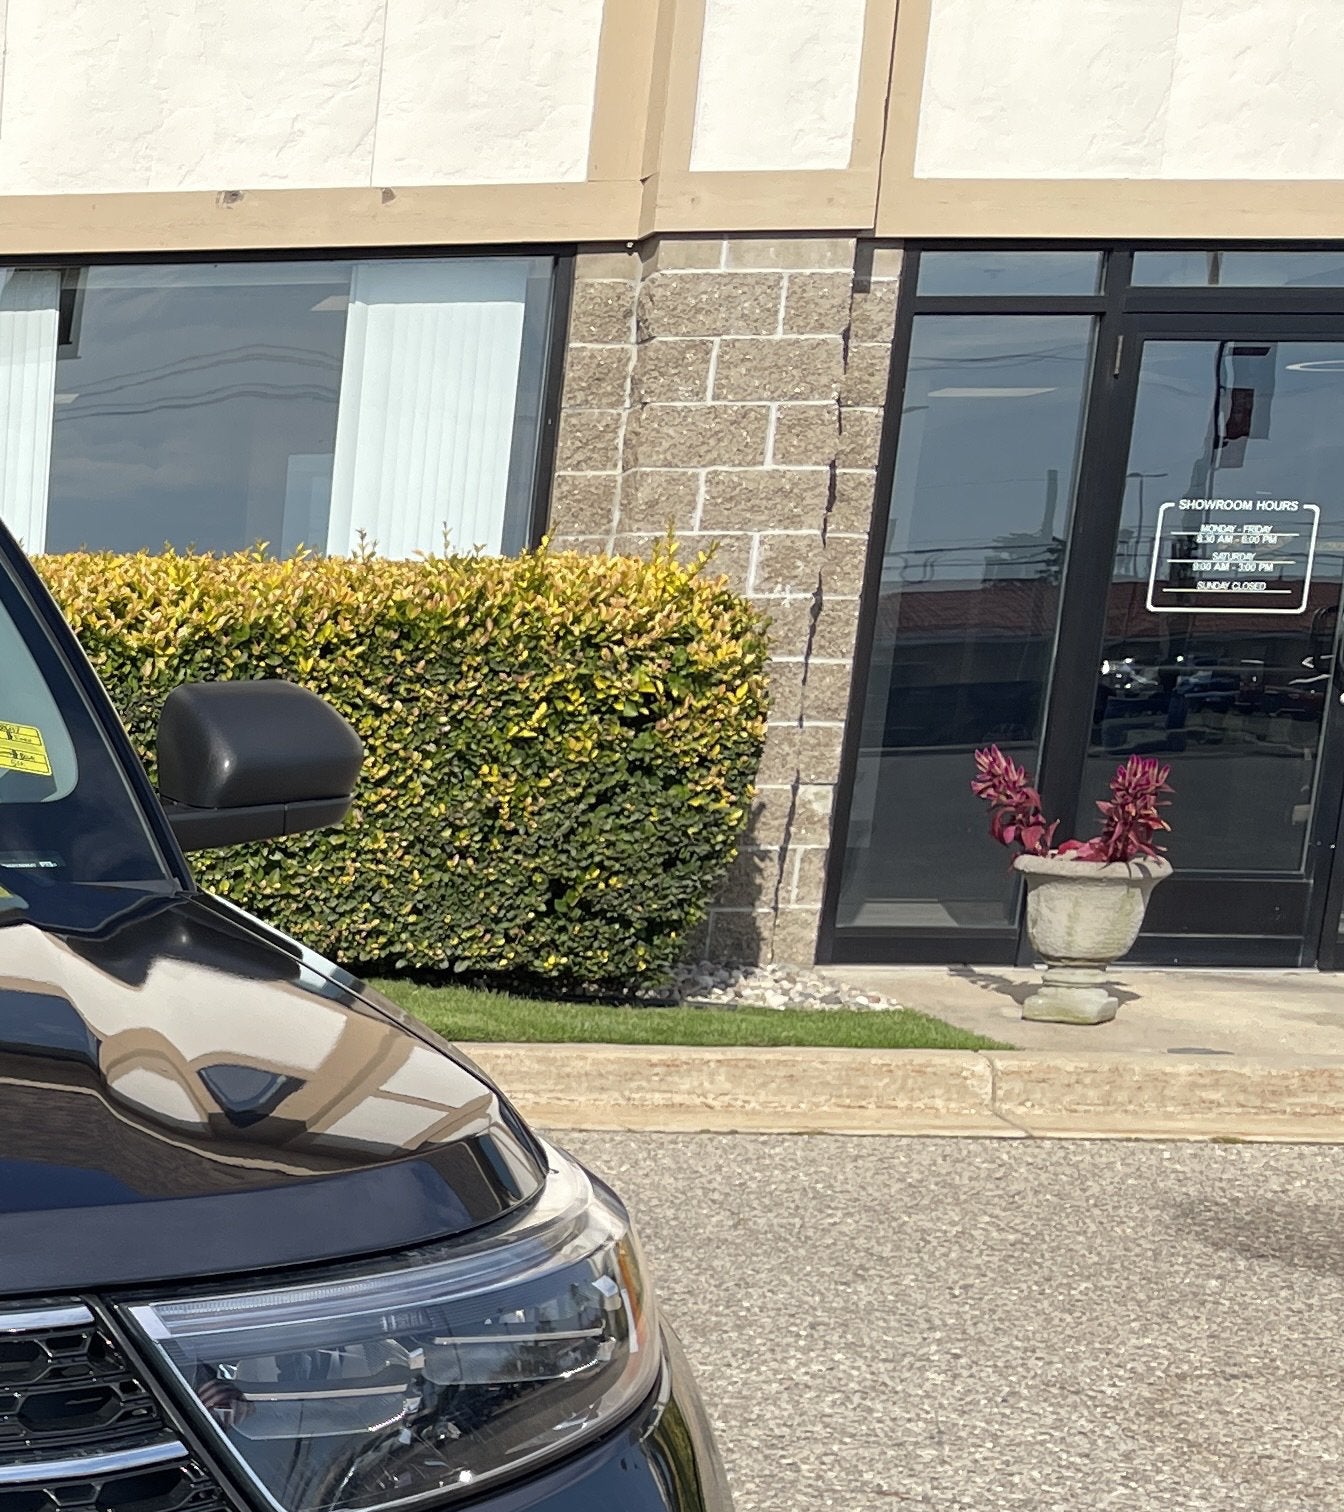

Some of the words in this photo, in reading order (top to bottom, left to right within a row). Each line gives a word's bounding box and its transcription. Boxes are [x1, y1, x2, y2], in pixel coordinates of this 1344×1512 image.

[1178, 499, 1253, 511] SHOWROOM
[1256, 500, 1300, 511] HOURS
[1200, 524, 1237, 533] MONDAY
[1242, 525, 1273, 534] FRIDAY
[1217, 535, 1233, 544] AM
[1262, 535, 1278, 544] PM
[1212, 552, 1256, 561] SATURDAY
[1213, 562, 1230, 571] AM
[1258, 563, 1274, 572] PM
[1196, 581, 1230, 590] SUNDAY
[1231, 582, 1267, 590] CLOSED
